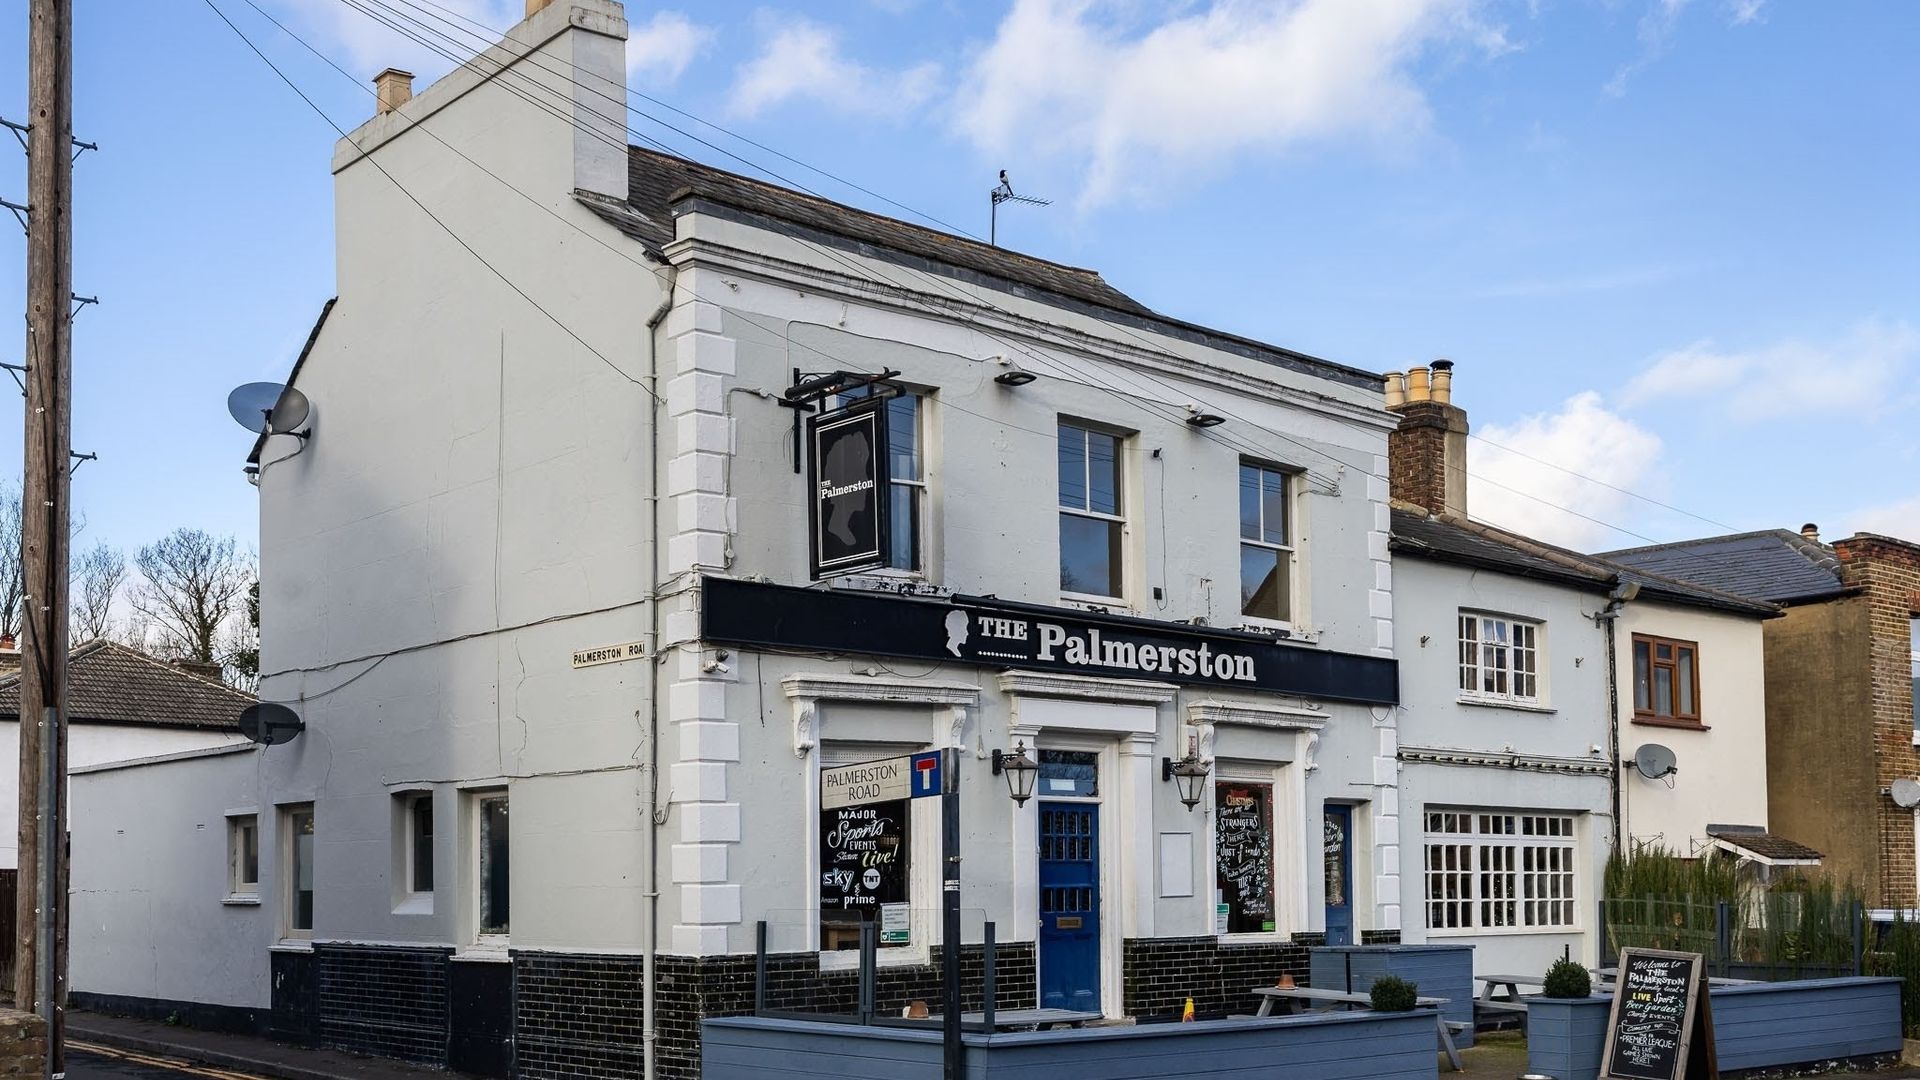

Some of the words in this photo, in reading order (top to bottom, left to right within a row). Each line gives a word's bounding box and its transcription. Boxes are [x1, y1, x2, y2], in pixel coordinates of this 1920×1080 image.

[821, 480, 873, 499] Palmerston
[573, 648, 621, 665] PALMERSTON
[978, 616, 1028, 641] THE
[1036, 622, 1257, 682] Palmerston
[827, 764, 897, 788] PALMERSTON
[848, 784, 880, 800] ROAD
[838, 810, 876, 820] MAJOR
[827, 818, 893, 849] Sports
[1229, 834, 1245, 843] HERE
[849, 841, 877, 850] EVENTS
[823, 868, 855, 893] sky
[864, 875, 880, 883] TNT
[844, 895, 876, 910] prime
[1628, 971, 1685, 986] PALMERSTON
[1646, 968, 1669, 977] THE
[1632, 992, 1652, 1001] LIVE
[1653, 992, 1678, 1004] Sport
[1625, 1000, 1643, 1009] Beer
[1643, 1002, 1677, 1013] Garden
